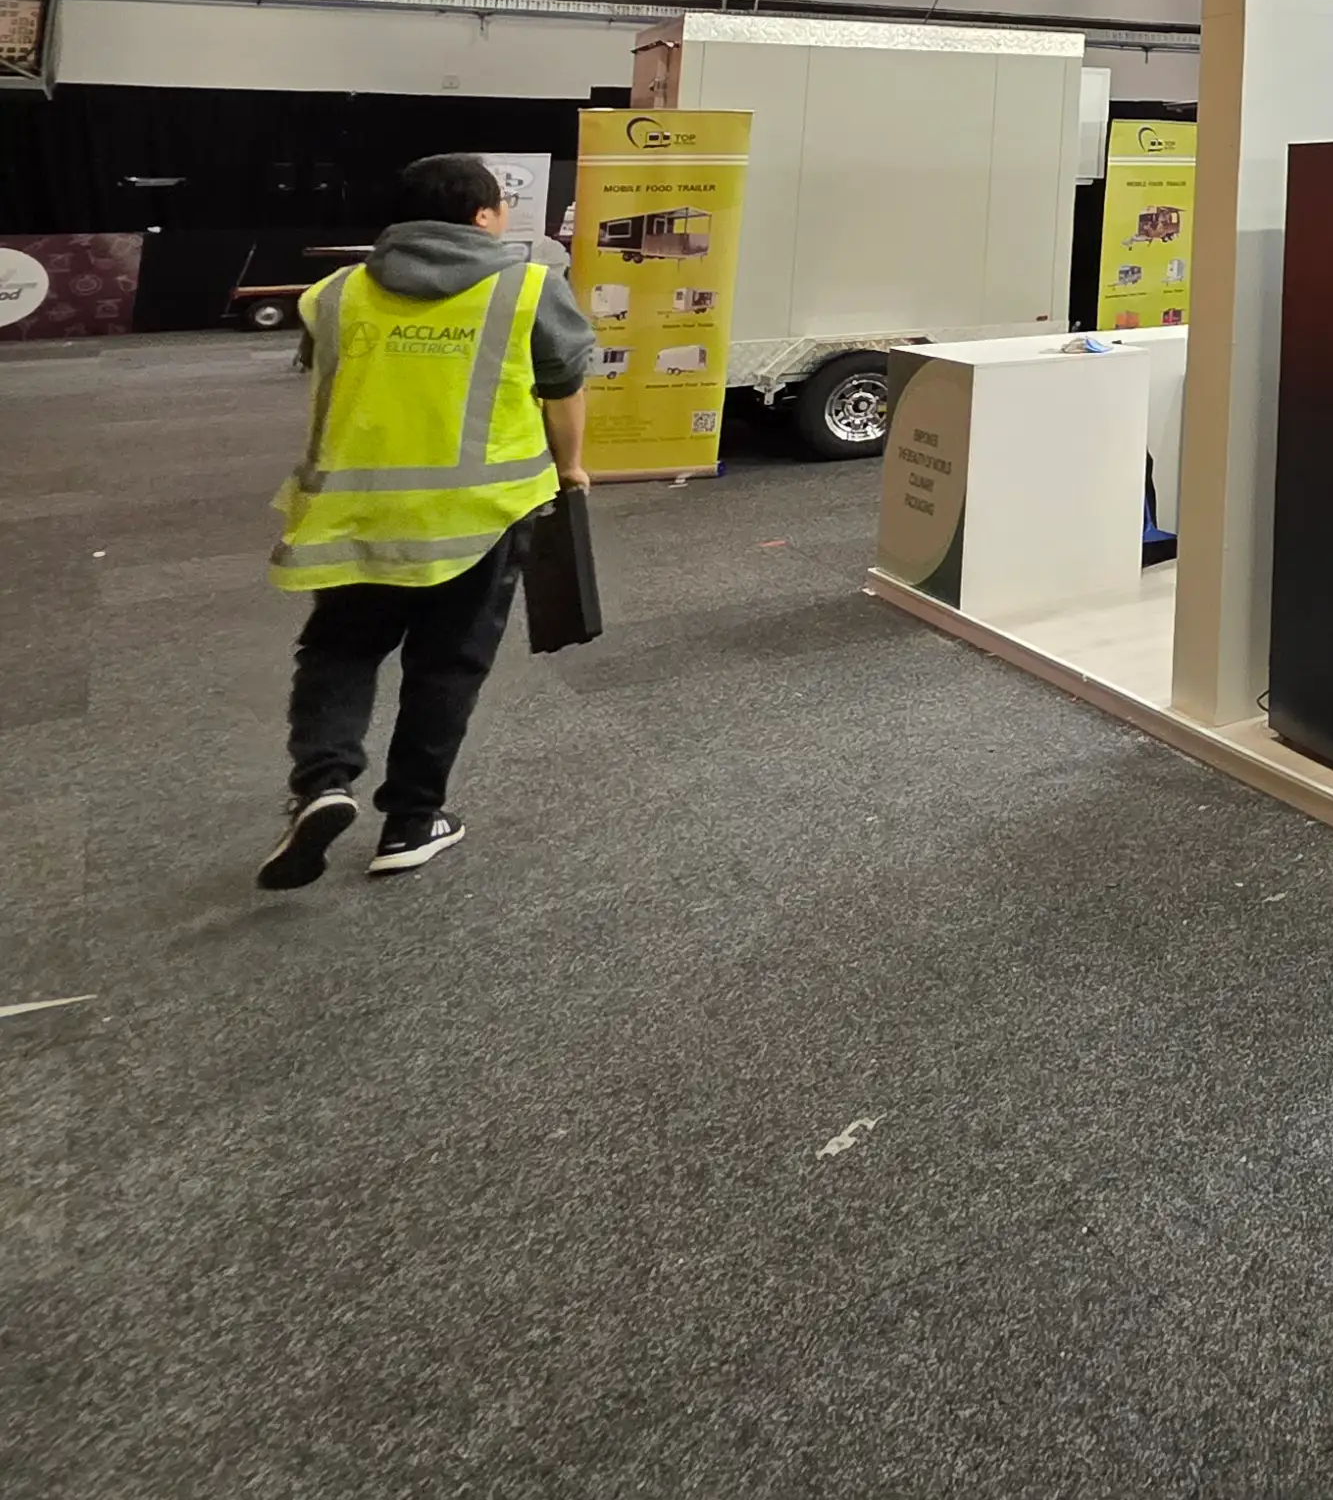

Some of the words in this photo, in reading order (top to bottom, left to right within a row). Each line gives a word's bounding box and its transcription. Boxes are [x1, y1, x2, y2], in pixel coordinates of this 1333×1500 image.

[675, 134, 696, 142] TOP
[603, 184, 642, 193] MOBILE
[646, 184, 673, 192] FOOD
[677, 184, 716, 192] TRAILER
[388, 325, 476, 342] ACCLAIM
[384, 341, 469, 356] ELECTRICAL
